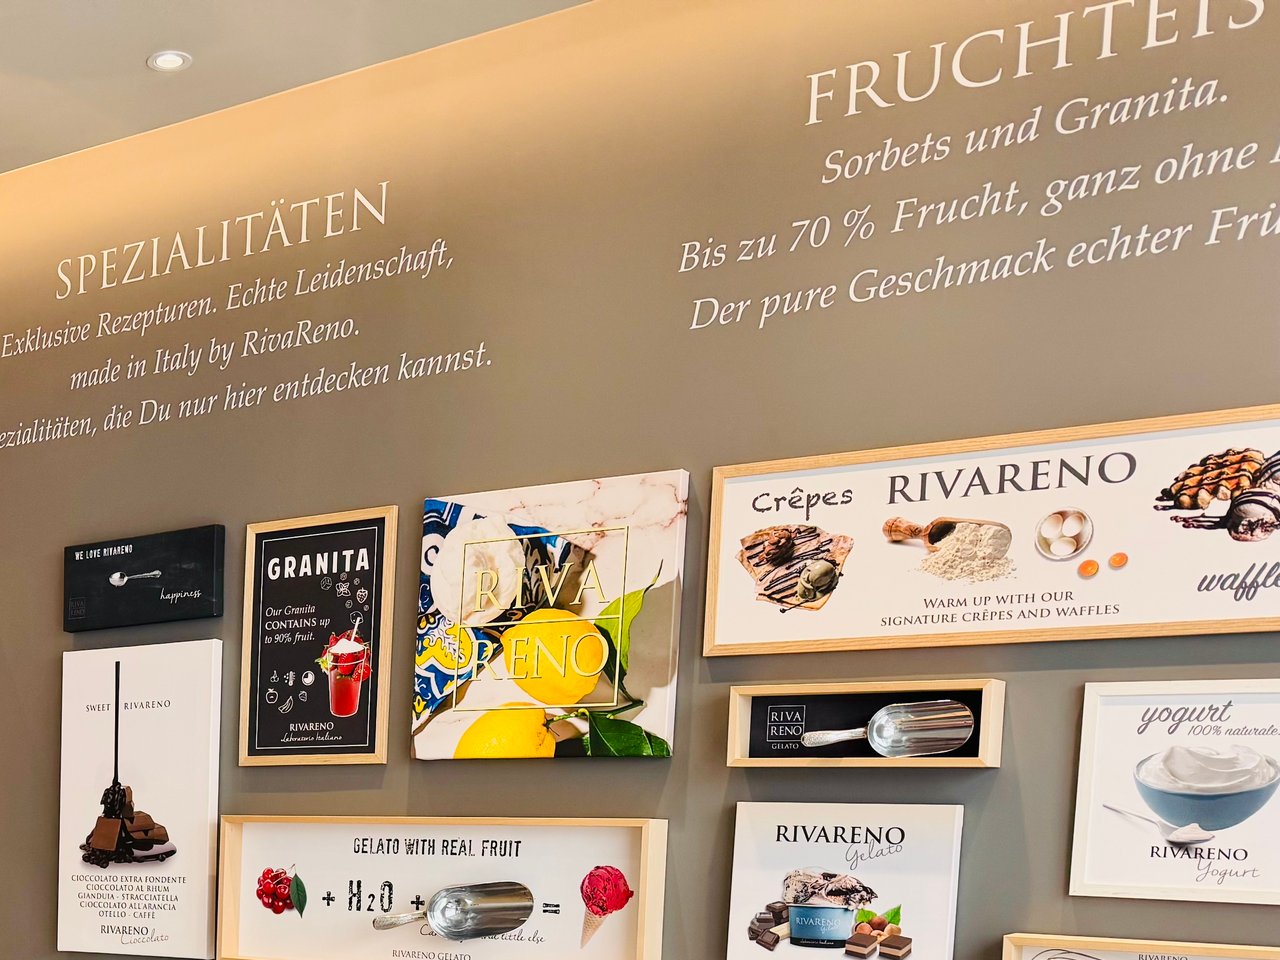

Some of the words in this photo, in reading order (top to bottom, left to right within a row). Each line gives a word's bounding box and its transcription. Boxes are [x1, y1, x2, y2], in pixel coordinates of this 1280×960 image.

[821, 133, 951, 184] Sorbets
[965, 107, 1040, 154] und
[1055, 77, 1228, 137] Granita.
[678, 241, 726, 273] Bis
[737, 233, 777, 262] zu
[789, 216, 831, 253] 70
[843, 208, 876, 247] %
[889, 180, 1029, 235] Frucht,
[1040, 160, 1141, 217] ganz
[1154, 141, 1259, 186] ohne
[56, 181, 390, 300] SPEZIALITÄTEN
[689, 296, 751, 331] Der
[759, 283, 837, 330] pure
[848, 241, 1057, 305] Geschmack
[1066, 222, 1193, 266] echter
[0, 322, 91, 358] Exklusive
[96, 298, 217, 338] Rezepturen.
[226, 279, 288, 311] Echte
[294, 238, 454, 297] Leidenschaft,
[70, 360, 120, 390] made
[126, 354, 147, 380] in
[153, 346, 202, 380] Italy
[208, 338, 234, 370] by
[240, 318, 360, 359] RivaReno.
[103, 406, 133, 432] die
[139, 399, 171, 426] Du
[178, 393, 218, 420] nur
[223, 383, 267, 412] hier
[273, 352, 389, 403] entdecken
[397, 341, 493, 381] kannst.
[886, 451, 1138, 505] RIVARENO
[751, 487, 854, 520] Crêpes
[75, 551, 84, 561] WE
[86, 548, 101, 559] LOVE
[103, 544, 133, 558] RIVARENO
[267, 547, 370, 580] GRANITA
[473, 559, 610, 613] RIVA
[160, 587, 202, 604] happiness
[923, 597, 969, 610] WARM
[972, 595, 992, 608] UP
[995, 593, 1037, 607] WITH
[1042, 590, 1075, 603] OUR
[265, 606, 282, 617] Our
[284, 604, 316, 616] Granita
[880, 612, 958, 627] SIGNATURE
[962, 606, 1013, 623] CRÊPES
[1016, 607, 1052, 620] AND
[1055, 603, 1121, 618] WAFFLES
[265, 618, 317, 631] CONTAINS
[320, 618, 331, 629] up
[265, 634, 272, 644] to
[274, 633, 292, 643] 90%
[293, 631, 315, 645] fruit.
[470, 632, 610, 682] RENO
[85, 703, 111, 712] SWEET
[124, 699, 171, 710] RIVARENO
[771, 711, 802, 722] RIVA
[1137, 700, 1233, 735] yogurt
[290, 721, 334, 731] RIVARENO
[770, 725, 802, 737] RENO
[1188, 725, 1222, 736] 100%
[776, 825, 906, 845] RIVARENO
[353, 837, 400, 856] GELATO
[404, 838, 436, 857] WITH
[441, 839, 476, 857] REAL
[481, 840, 522, 858] FRUIT
[845, 839, 903, 870] Gelato
[1150, 845, 1249, 862] RIVARENO
[71, 874, 118, 883] CIOCCOLATO
[120, 875, 143, 883] EXTRA
[145, 876, 187, 884] FONDENTE
[1196, 856, 1261, 885] Yogurt
[86, 883, 134, 891] CIOCCOLATO
[77, 892, 115, 900] GIANDUIA
[121, 893, 179, 902] STRACCIATELLA
[79, 901, 127, 909] CIOCCOLATO
[128, 902, 177, 911] ALL'ARANCIA
[98, 910, 127, 918] OTELLO
[795, 917, 841, 927] RIVARENO
[100, 925, 149, 936] RIVARENO
[121, 928, 169, 945] Cioccolato
